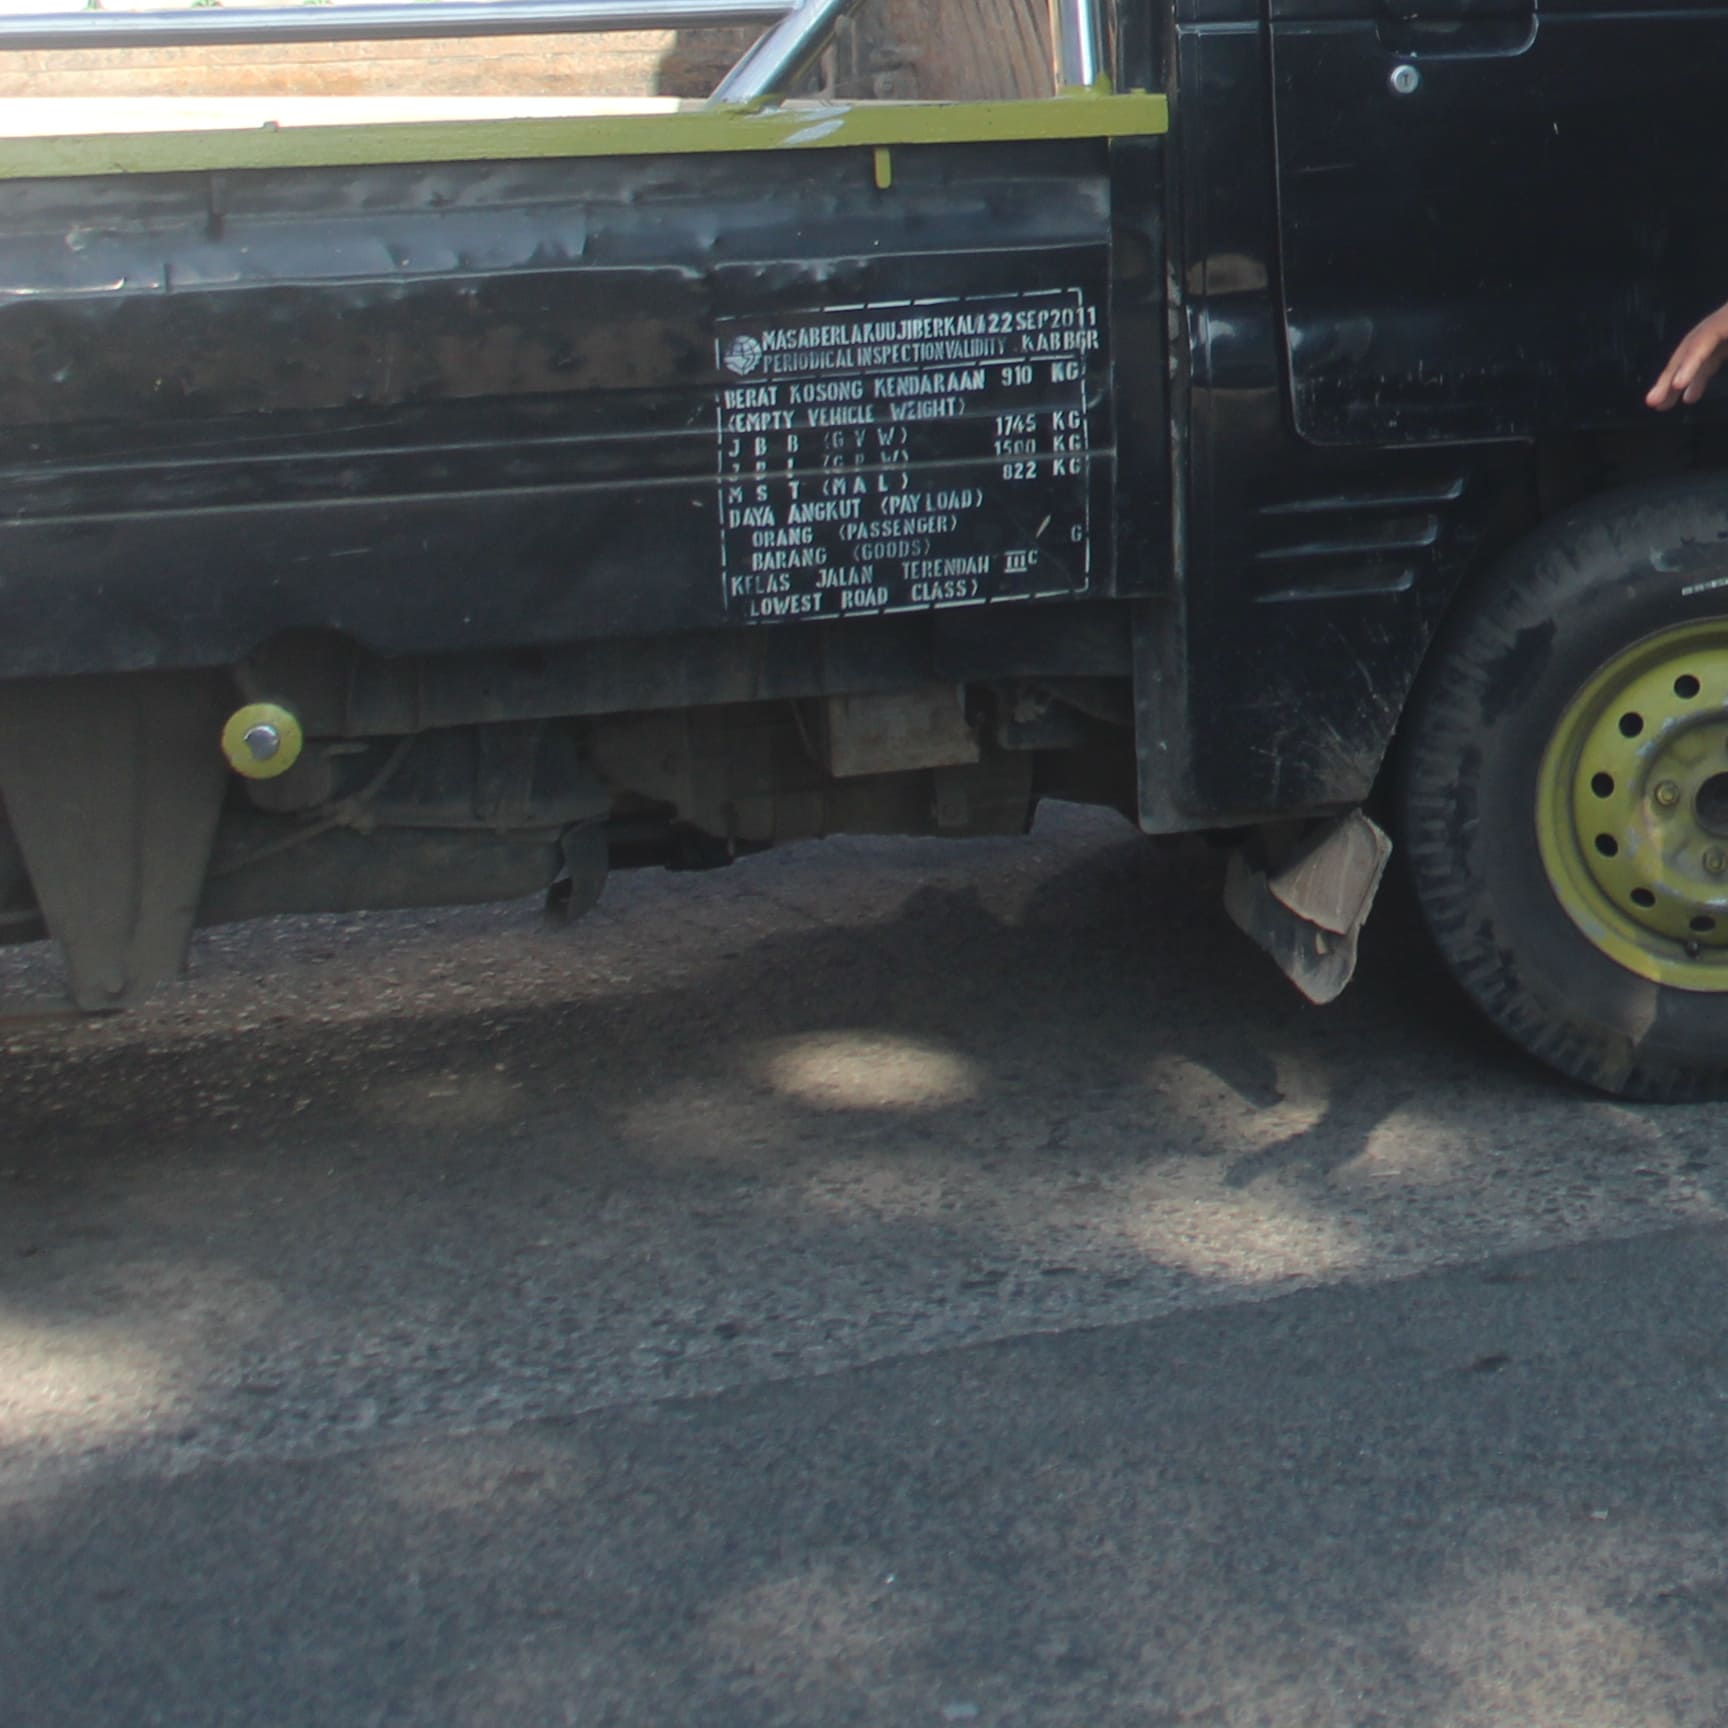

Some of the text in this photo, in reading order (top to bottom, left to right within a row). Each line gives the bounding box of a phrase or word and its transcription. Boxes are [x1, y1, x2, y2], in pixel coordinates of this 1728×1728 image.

[725, 362, 1079, 409] BERAT KOSONG KENDARAAN 910 KG
[727, 405, 795, 432] (EMPTY
[808, 404, 874, 427] VEHICLE
[1053, 410, 1081, 431] KG
[1002, 460, 1037, 481] 822
[1053, 458, 1081, 476] KG
[730, 504, 775, 529] DAYA
[788, 499, 861, 523] ANGKUT
[753, 528, 813, 548] ORANG
[839, 514, 957, 541] (PASSENGER)
[753, 540, 931, 572] BARANG (GOODS)
[816, 565, 873, 588] JALAN
[902, 558, 989, 581] TERENDAH
[841, 587, 888, 609] ROAD
[911, 578, 979, 602] CLASS)
